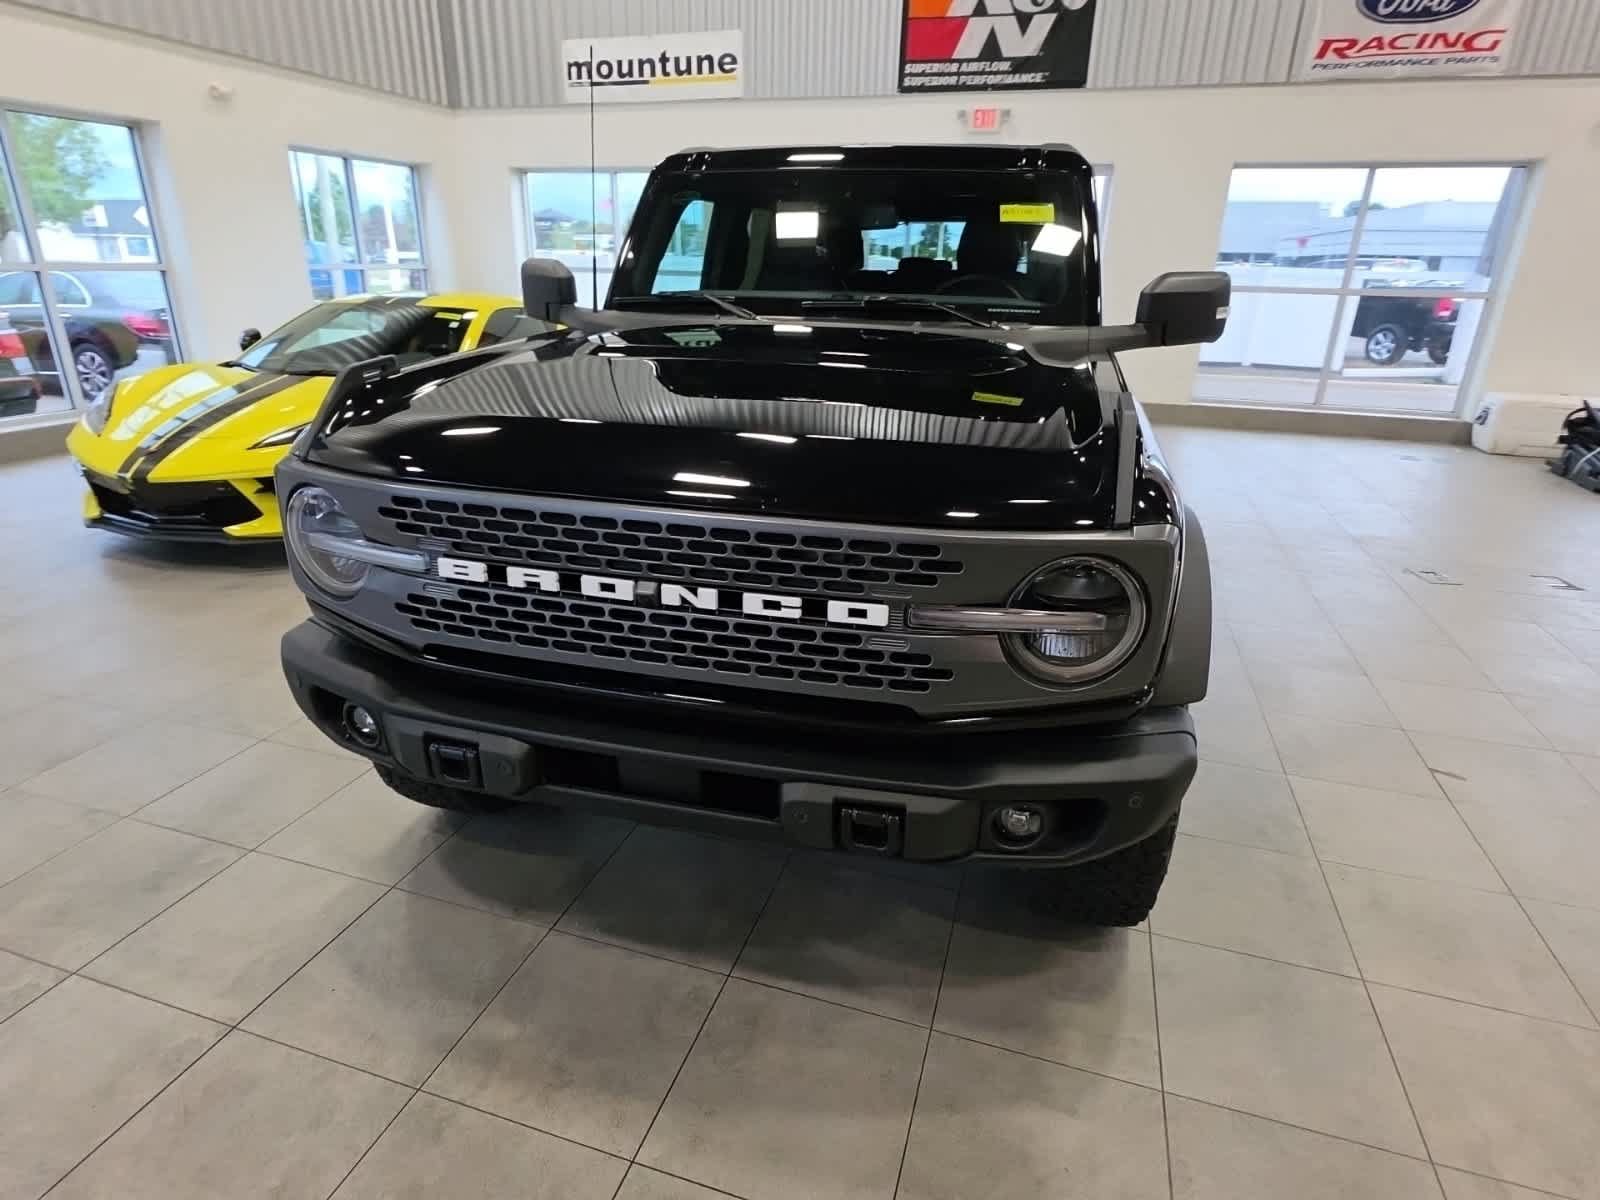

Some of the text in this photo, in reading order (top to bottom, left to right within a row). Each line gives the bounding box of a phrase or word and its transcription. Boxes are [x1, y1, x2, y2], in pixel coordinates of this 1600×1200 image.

[1314, 29, 1508, 60] RACING
[567, 50, 738, 80] mountune
[904, 62, 959, 73] SUPERIOR
[1312, 55, 1500, 70] PERFORMANCE PARTS
[903, 76, 958, 86] SUPERIOR
[438, 557, 889, 627] BRONCO
